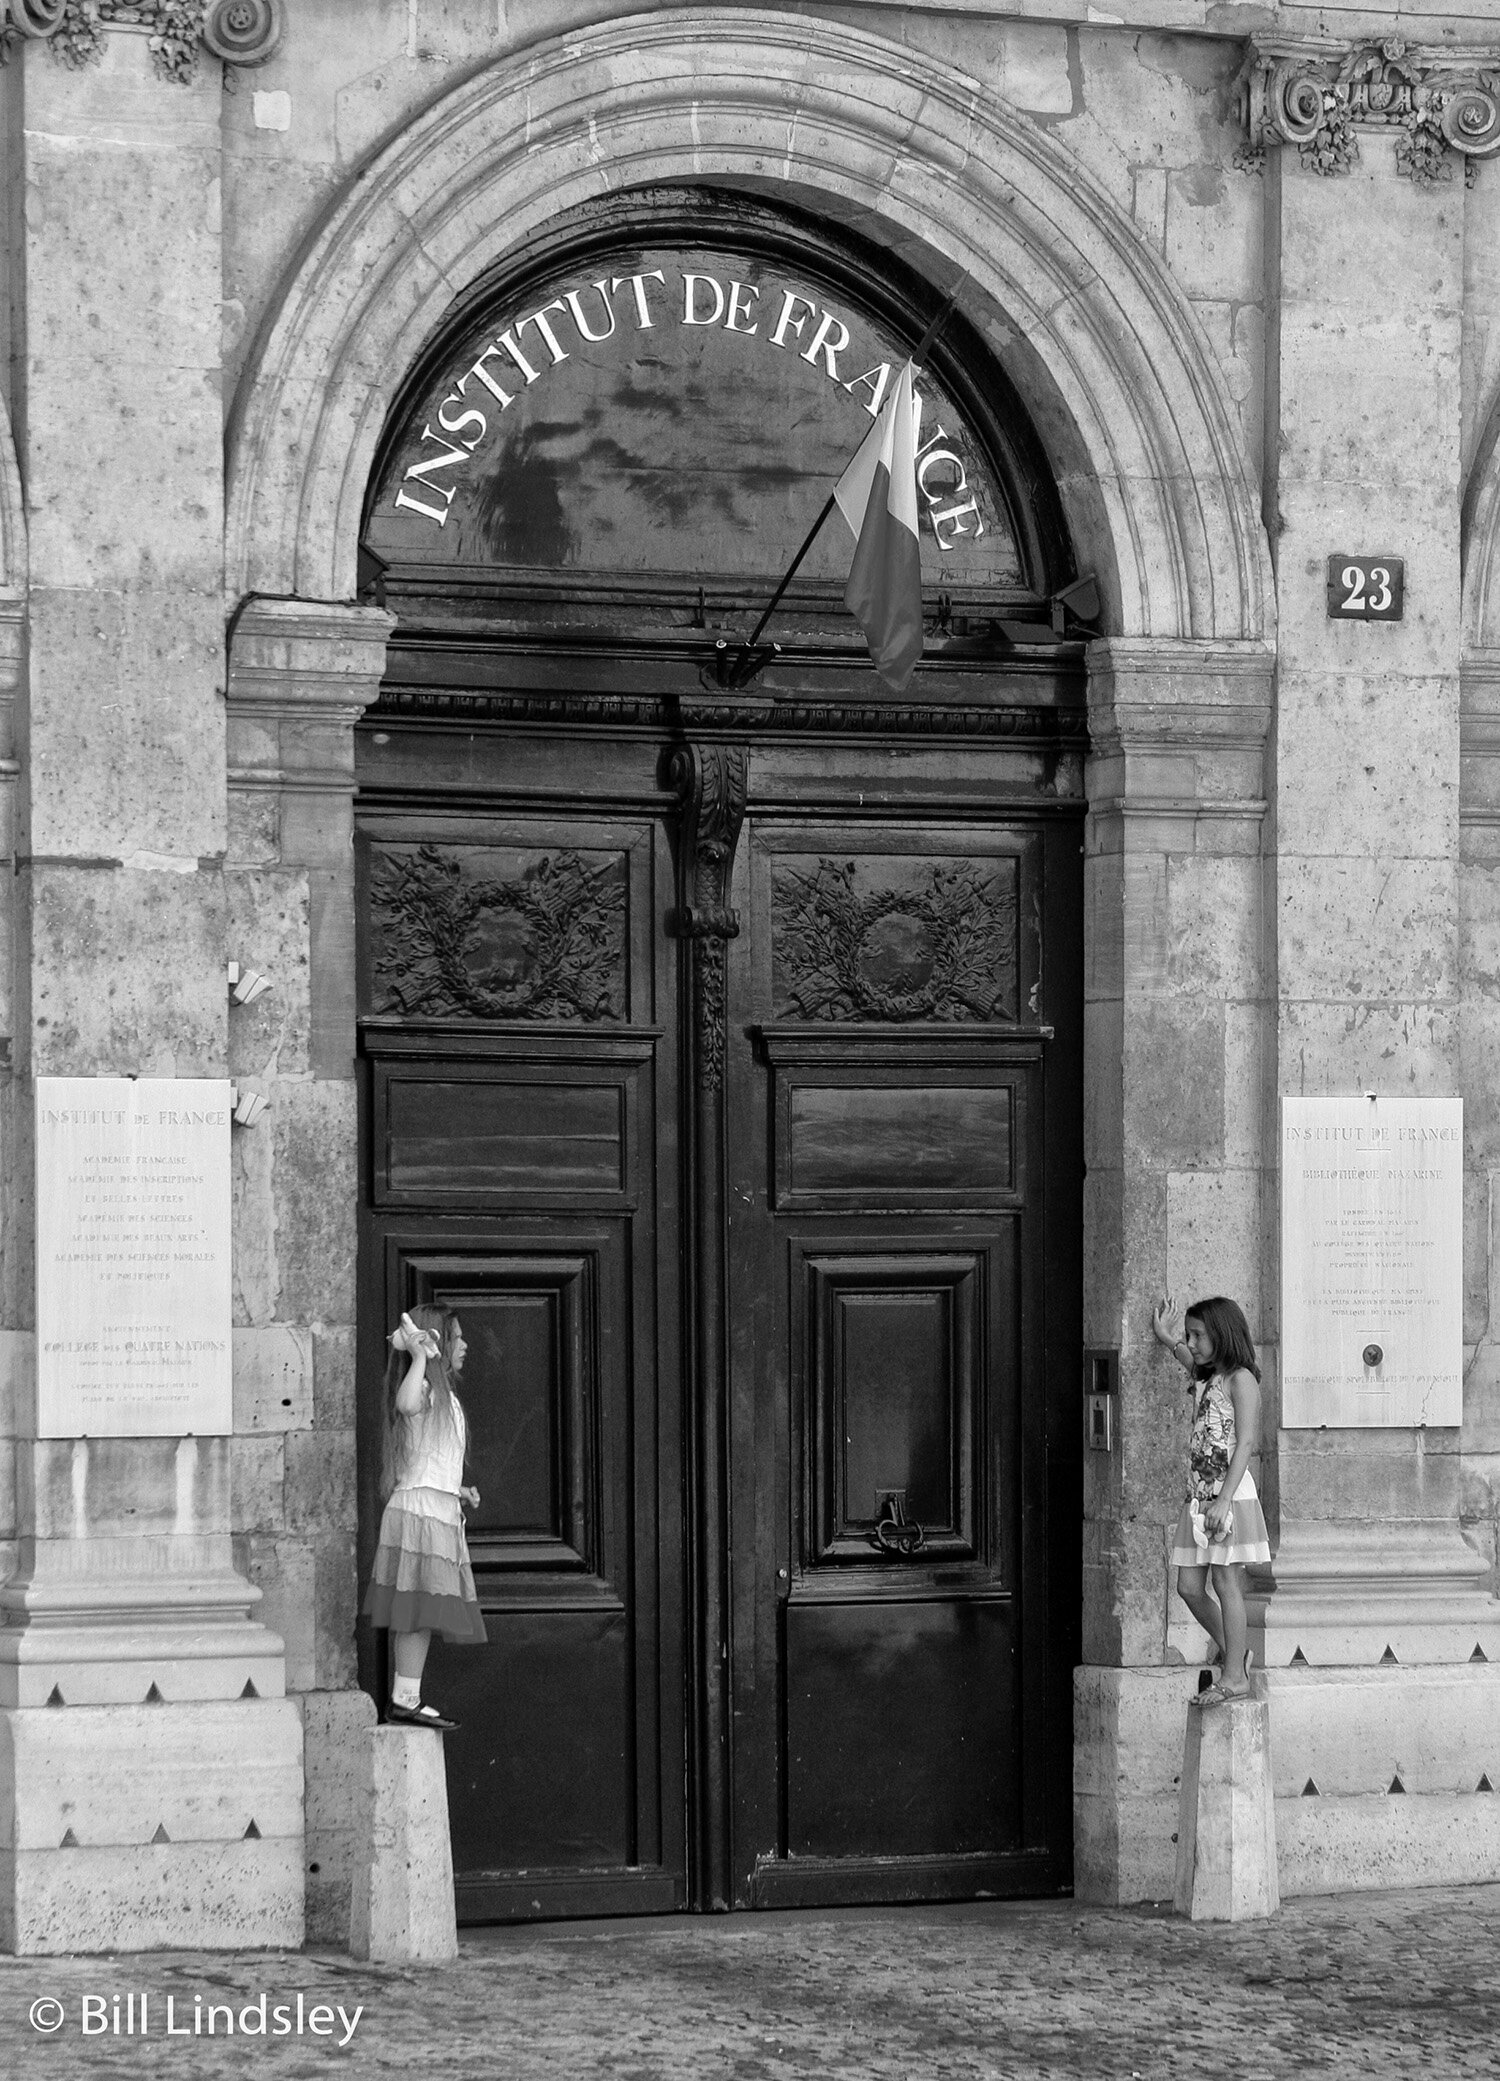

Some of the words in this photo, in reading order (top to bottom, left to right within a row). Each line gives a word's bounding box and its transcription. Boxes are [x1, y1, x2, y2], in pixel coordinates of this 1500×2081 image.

[394, 270, 667, 527] INSTITUT
[681, 273, 761, 336] DE
[1341, 566, 1392, 611] 23
[41, 1109, 126, 1125] INSTITUT
[134, 1114, 150, 1125] DE
[159, 1110, 226, 1126] FRANCE
[1286, 1127, 1364, 1141] INSTITUT
[1371, 1127, 1390, 1141] DE
[1399, 1127, 1460, 1141] FRANCE
